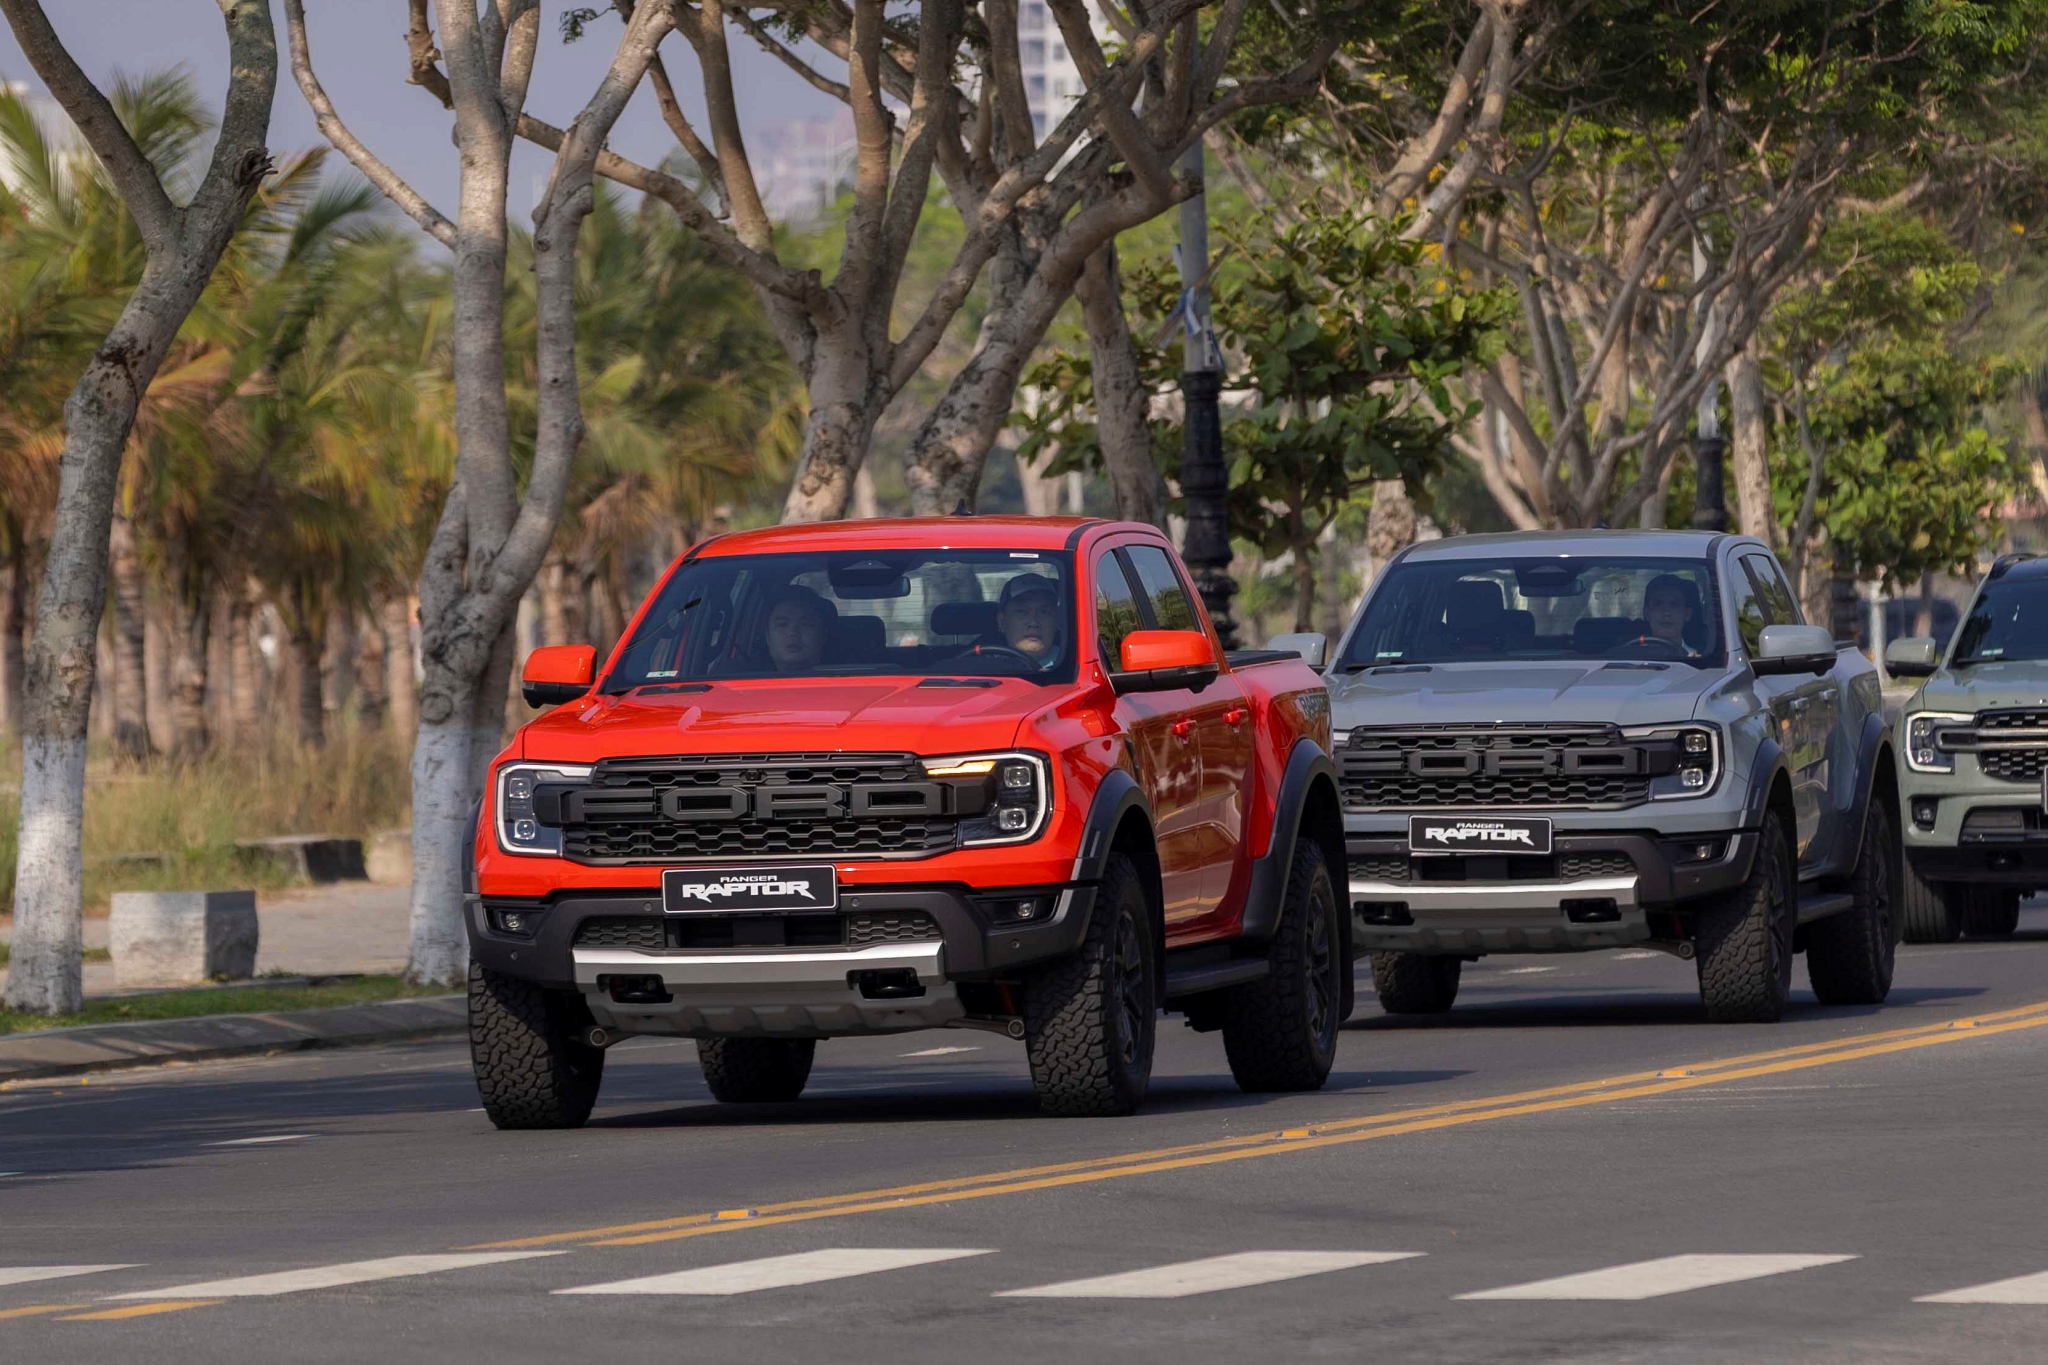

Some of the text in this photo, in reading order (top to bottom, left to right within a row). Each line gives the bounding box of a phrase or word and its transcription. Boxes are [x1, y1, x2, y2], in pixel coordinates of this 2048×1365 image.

[1336, 748, 1639, 778] FORD
[568, 784, 942, 822] FORD
[1425, 828, 1535, 846] RAPTOR
[720, 875, 777, 883] RANGER
[682, 881, 816, 903] RAPTOR
